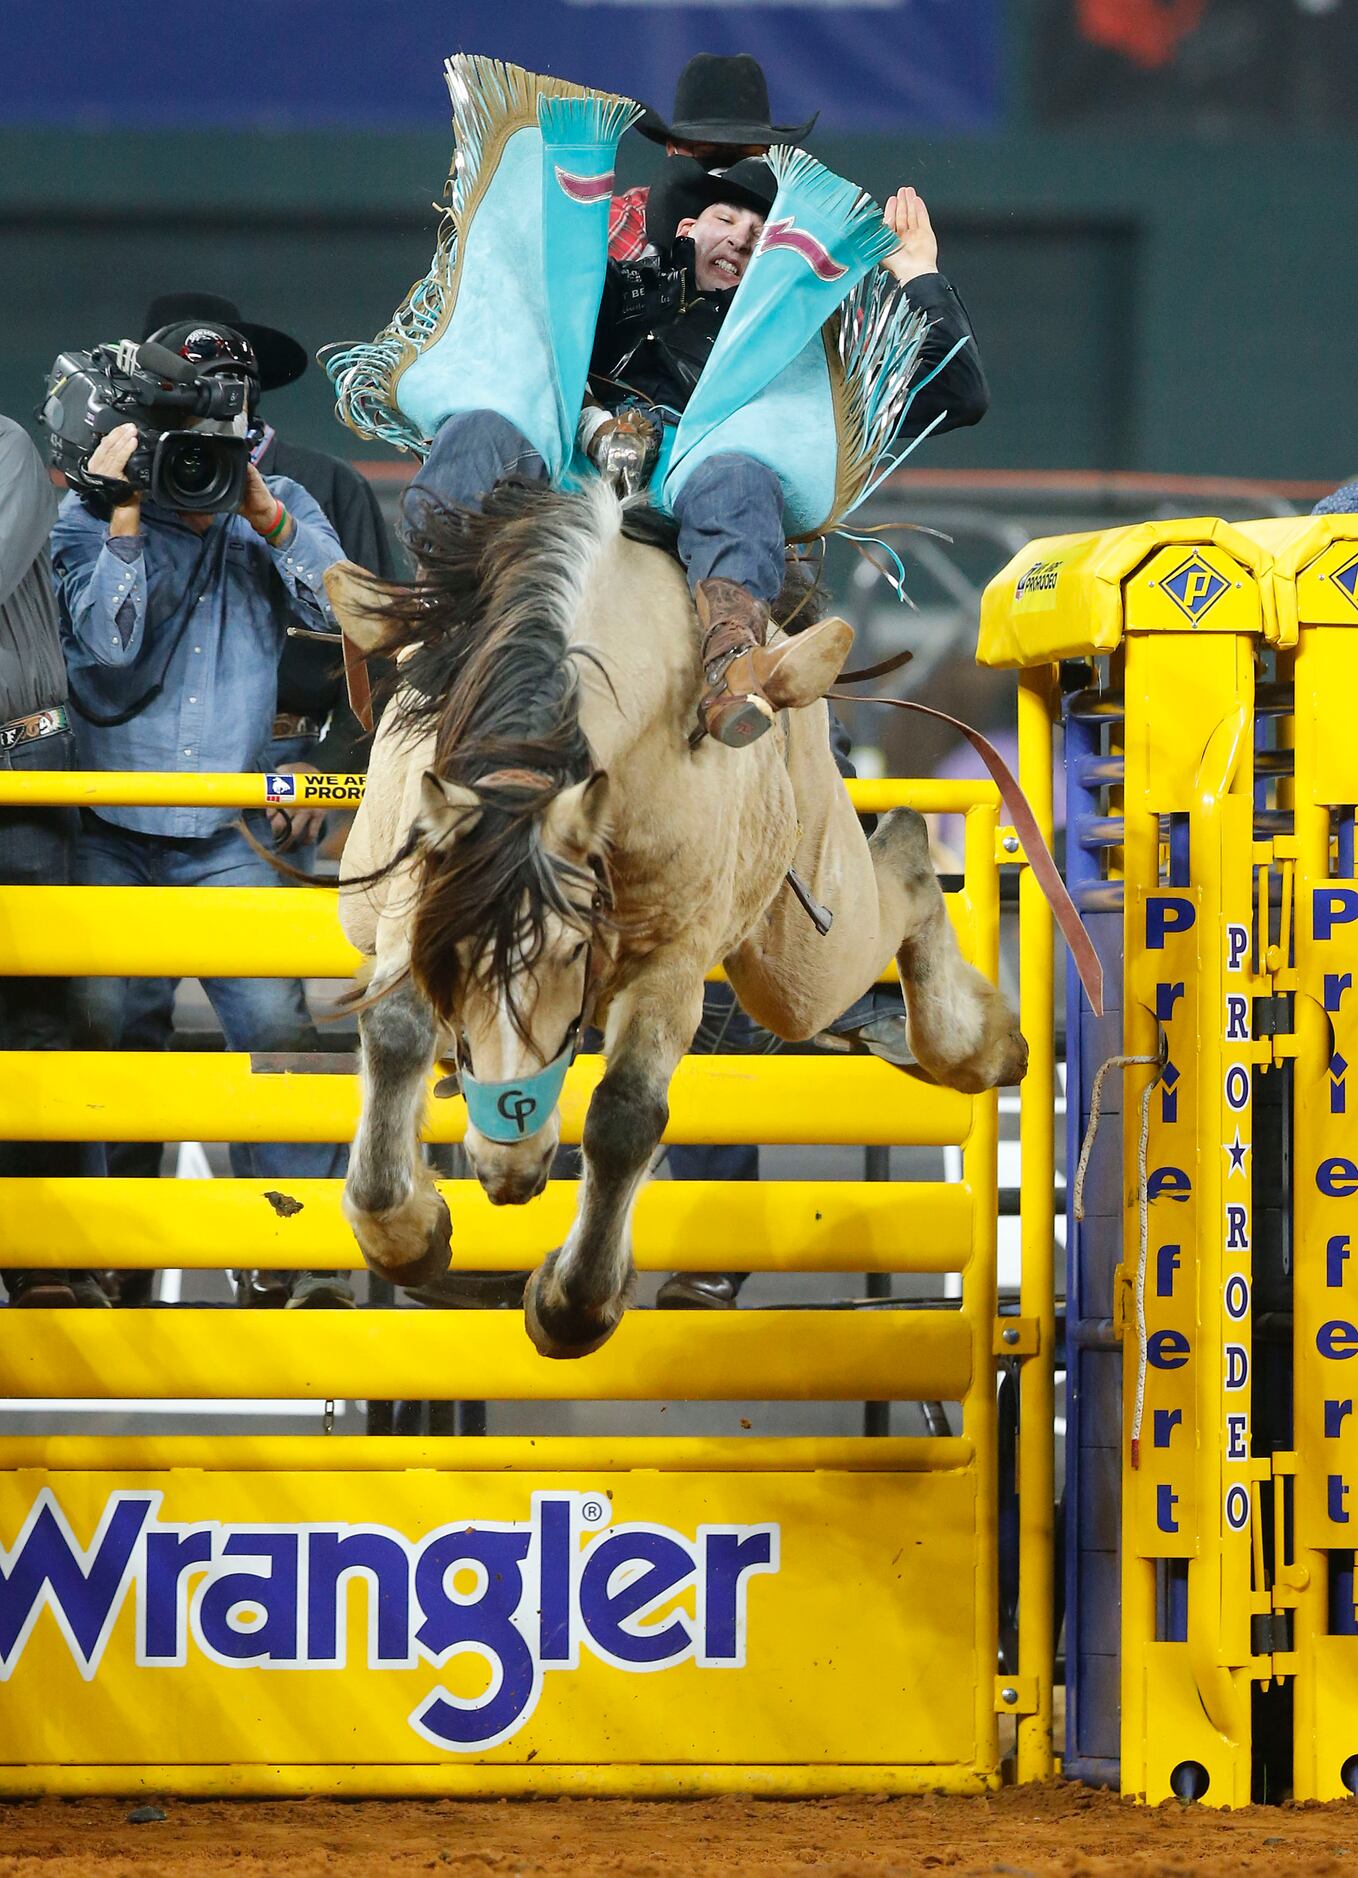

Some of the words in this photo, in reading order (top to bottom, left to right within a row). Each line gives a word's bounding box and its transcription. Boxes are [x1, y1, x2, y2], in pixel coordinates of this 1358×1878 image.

[1183, 571, 1212, 608] P
[304, 775, 338, 785] WE
[1227, 926, 1250, 1109] PRO
[1146, 897, 1196, 1533] Priefert
[1312, 888, 1358, 1523] Priefert
[1226, 1205, 1250, 1530] RODEO
[0, 1495, 775, 1747] Wrangler
